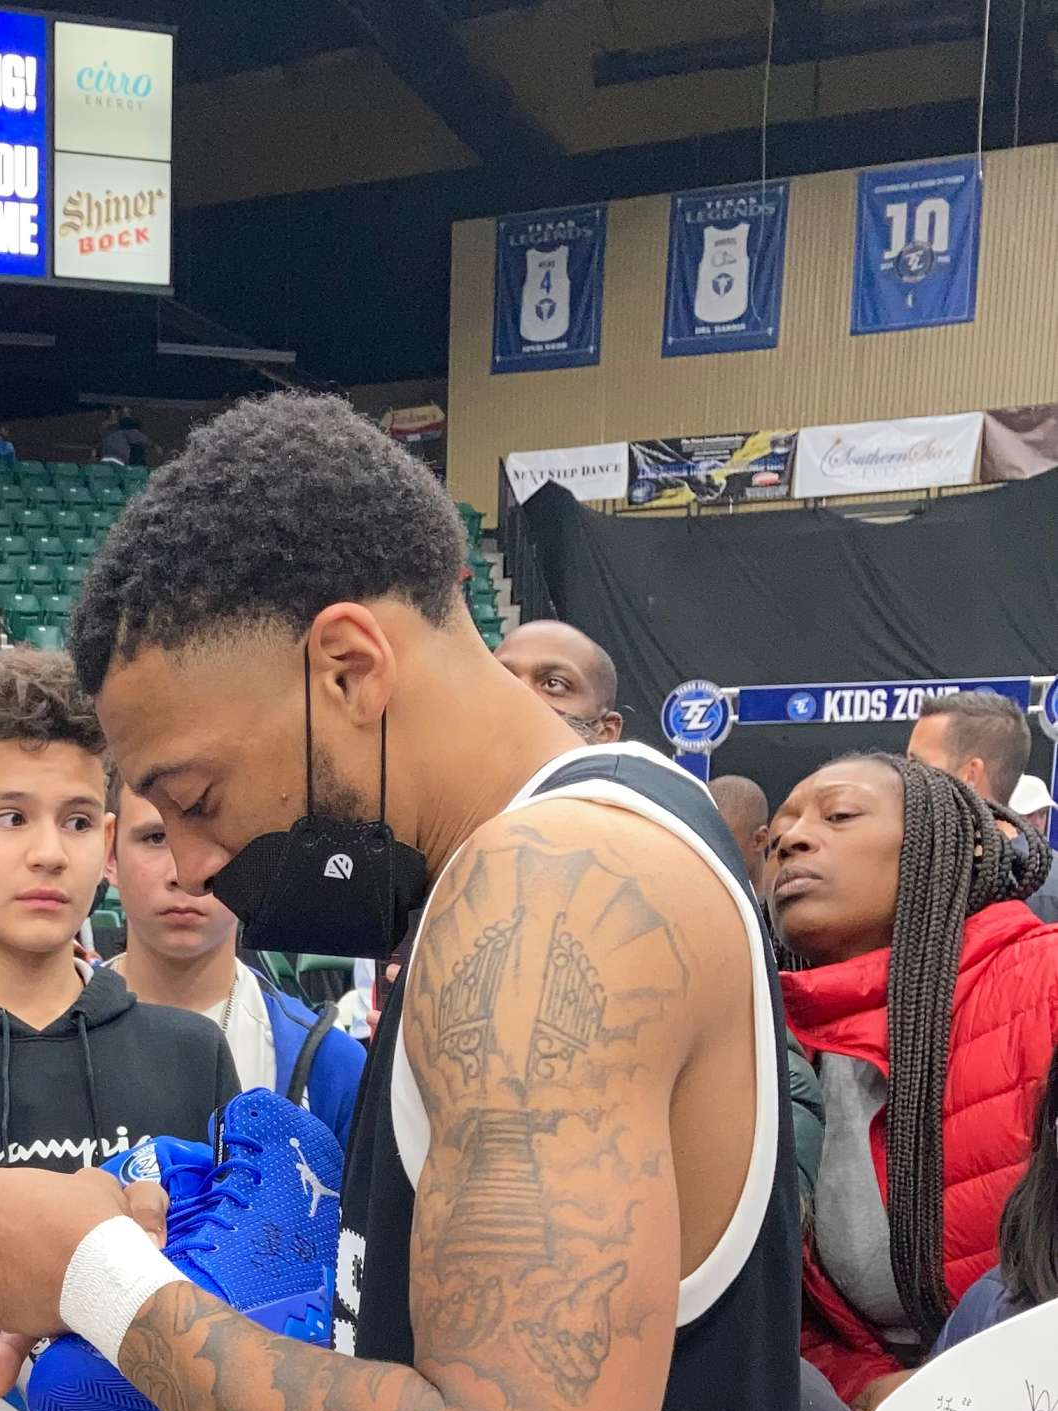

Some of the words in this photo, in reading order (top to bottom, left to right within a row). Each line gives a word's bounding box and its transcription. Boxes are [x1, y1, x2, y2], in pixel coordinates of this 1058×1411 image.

[76, 60, 152, 97] cirro
[85, 97, 144, 112] ENERGY
[59, 188, 165, 238] Shiner
[884, 198, 951, 260] 10
[78, 227, 151, 256] BOCK
[540, 270, 552, 294] 4
[581, 463, 622, 477] DANCE
[823, 689, 888, 723] KIDS
[891, 686, 960, 721] ZO
